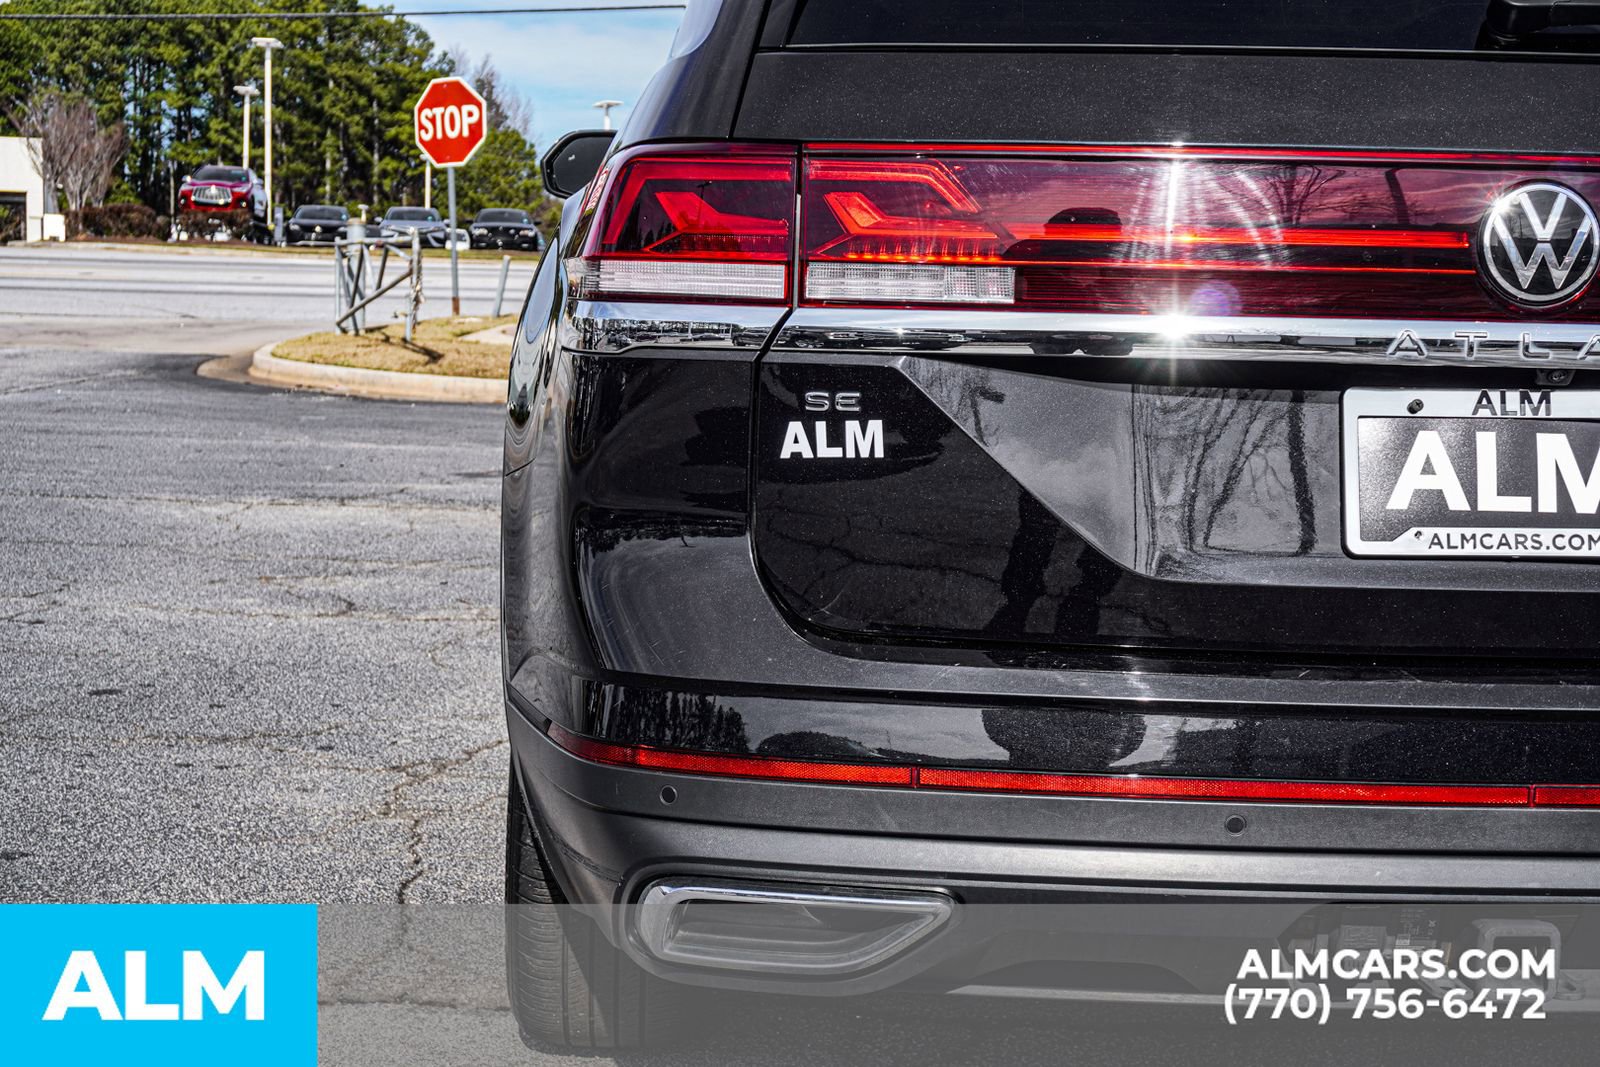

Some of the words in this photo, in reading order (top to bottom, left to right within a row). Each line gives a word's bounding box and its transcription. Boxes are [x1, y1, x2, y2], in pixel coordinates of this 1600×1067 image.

[420, 104, 480, 142] STOP
[804, 391, 861, 412] SE
[1471, 389, 1552, 416] ALM
[779, 419, 885, 459] ALM
[1386, 430, 1600, 514] ALM
[1428, 533, 1600, 551] ALMCARS.COM
